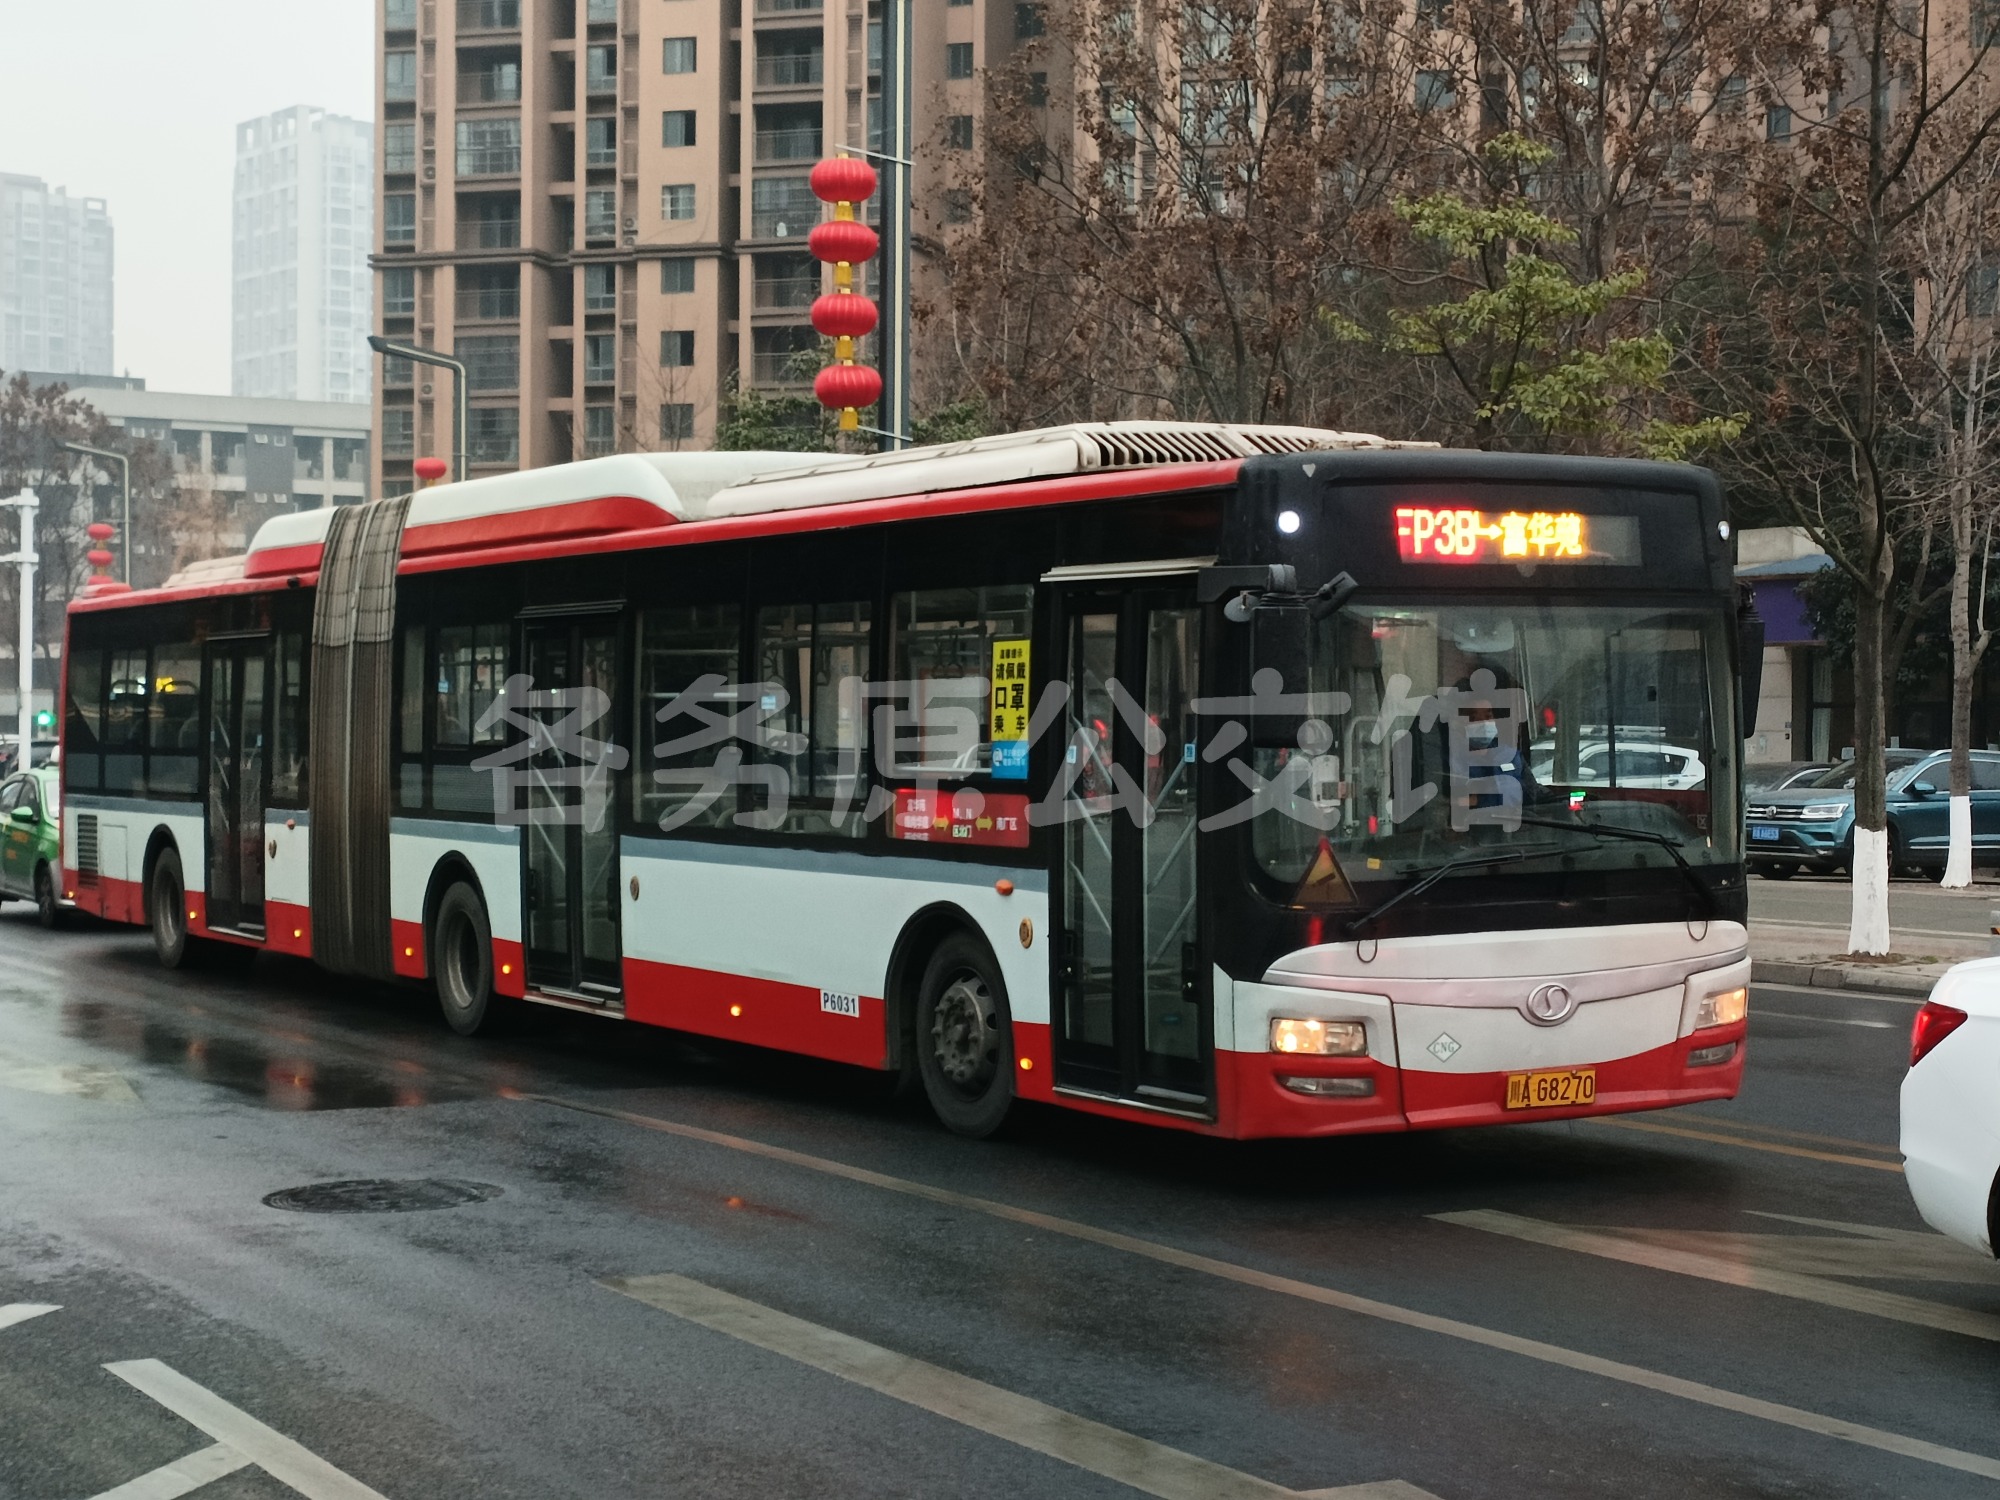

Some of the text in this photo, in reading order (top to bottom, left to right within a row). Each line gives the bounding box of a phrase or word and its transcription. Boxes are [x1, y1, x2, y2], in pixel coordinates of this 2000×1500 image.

[995, 683, 1025, 711] 口罩
[823, 992, 856, 1014] P6031
[1433, 1041, 1455, 1054] CNG
